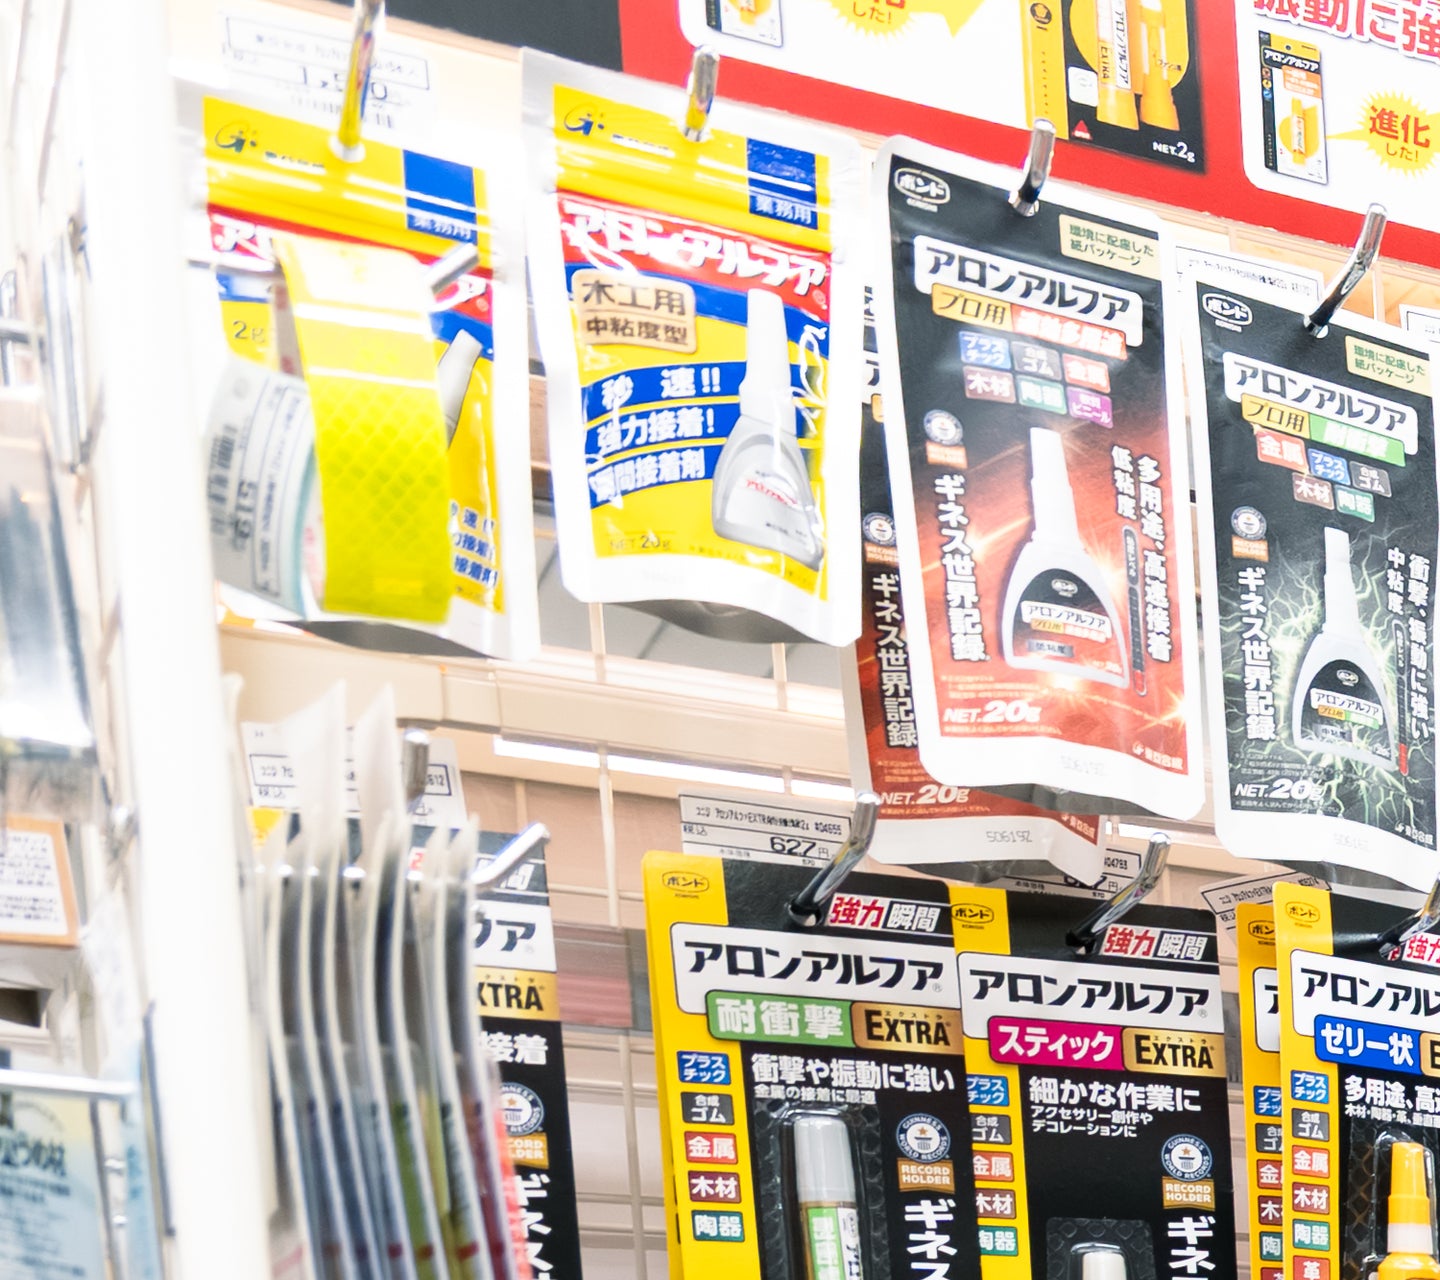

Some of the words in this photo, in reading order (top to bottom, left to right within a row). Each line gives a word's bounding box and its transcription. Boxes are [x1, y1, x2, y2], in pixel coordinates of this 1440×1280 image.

[1370, 106, 1429, 148] 進化
[581, 278, 686, 316] 木工用
[939, 289, 1008, 326] プロ用
[934, 475, 985, 663] ギネス世界記録
[769, 836, 811, 858] 627
[715, 997, 844, 1039] 耐衝撃
[864, 1012, 951, 1047] EXTRA
[998, 1027, 1115, 1060] スティック
[1134, 1042, 1215, 1069] EXTRA
[1320, 1023, 1414, 1064] ゼリー状
[751, 1053, 954, 1093] 衝撃や振動に強い
[1028, 1074, 1202, 1113] 細かな作業に
[687, 1134, 736, 1160] 金属
[691, 1175, 738, 1198] 木材
[1294, 1186, 1328, 1208] 木材
[694, 1214, 741, 1239] 陶器
[1294, 1222, 1328, 1245] 陶器
